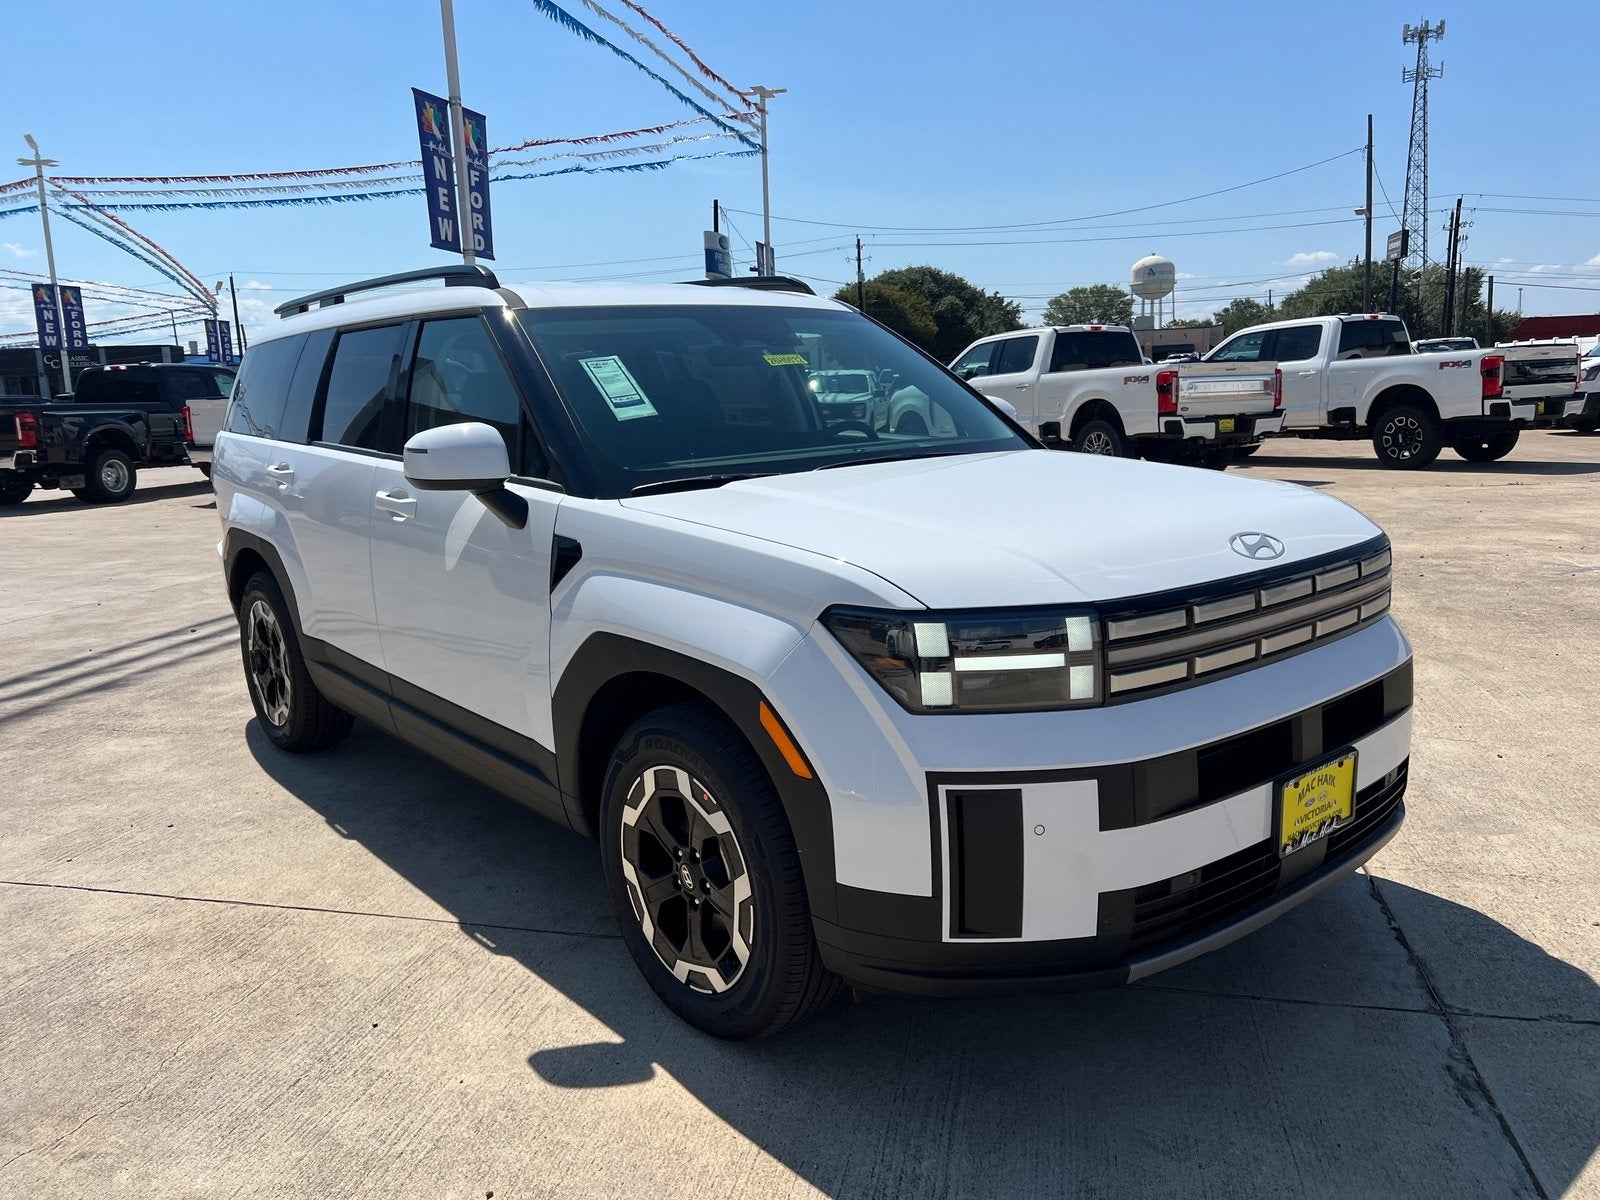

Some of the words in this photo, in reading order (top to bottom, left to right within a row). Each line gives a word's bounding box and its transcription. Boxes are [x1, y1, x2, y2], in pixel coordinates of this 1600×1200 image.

[433, 155, 453, 242] NEW
[470, 169, 485, 252] FORD
[43, 309, 57, 346] NEW
[71, 311, 83, 347] FORD
[223, 336, 231, 361] FORD
[1439, 360, 1472, 370] FX4
[1123, 375, 1150, 385] FX4
[1297, 778, 1317, 806] MAC
[1317, 773, 1336, 787] HAIK
